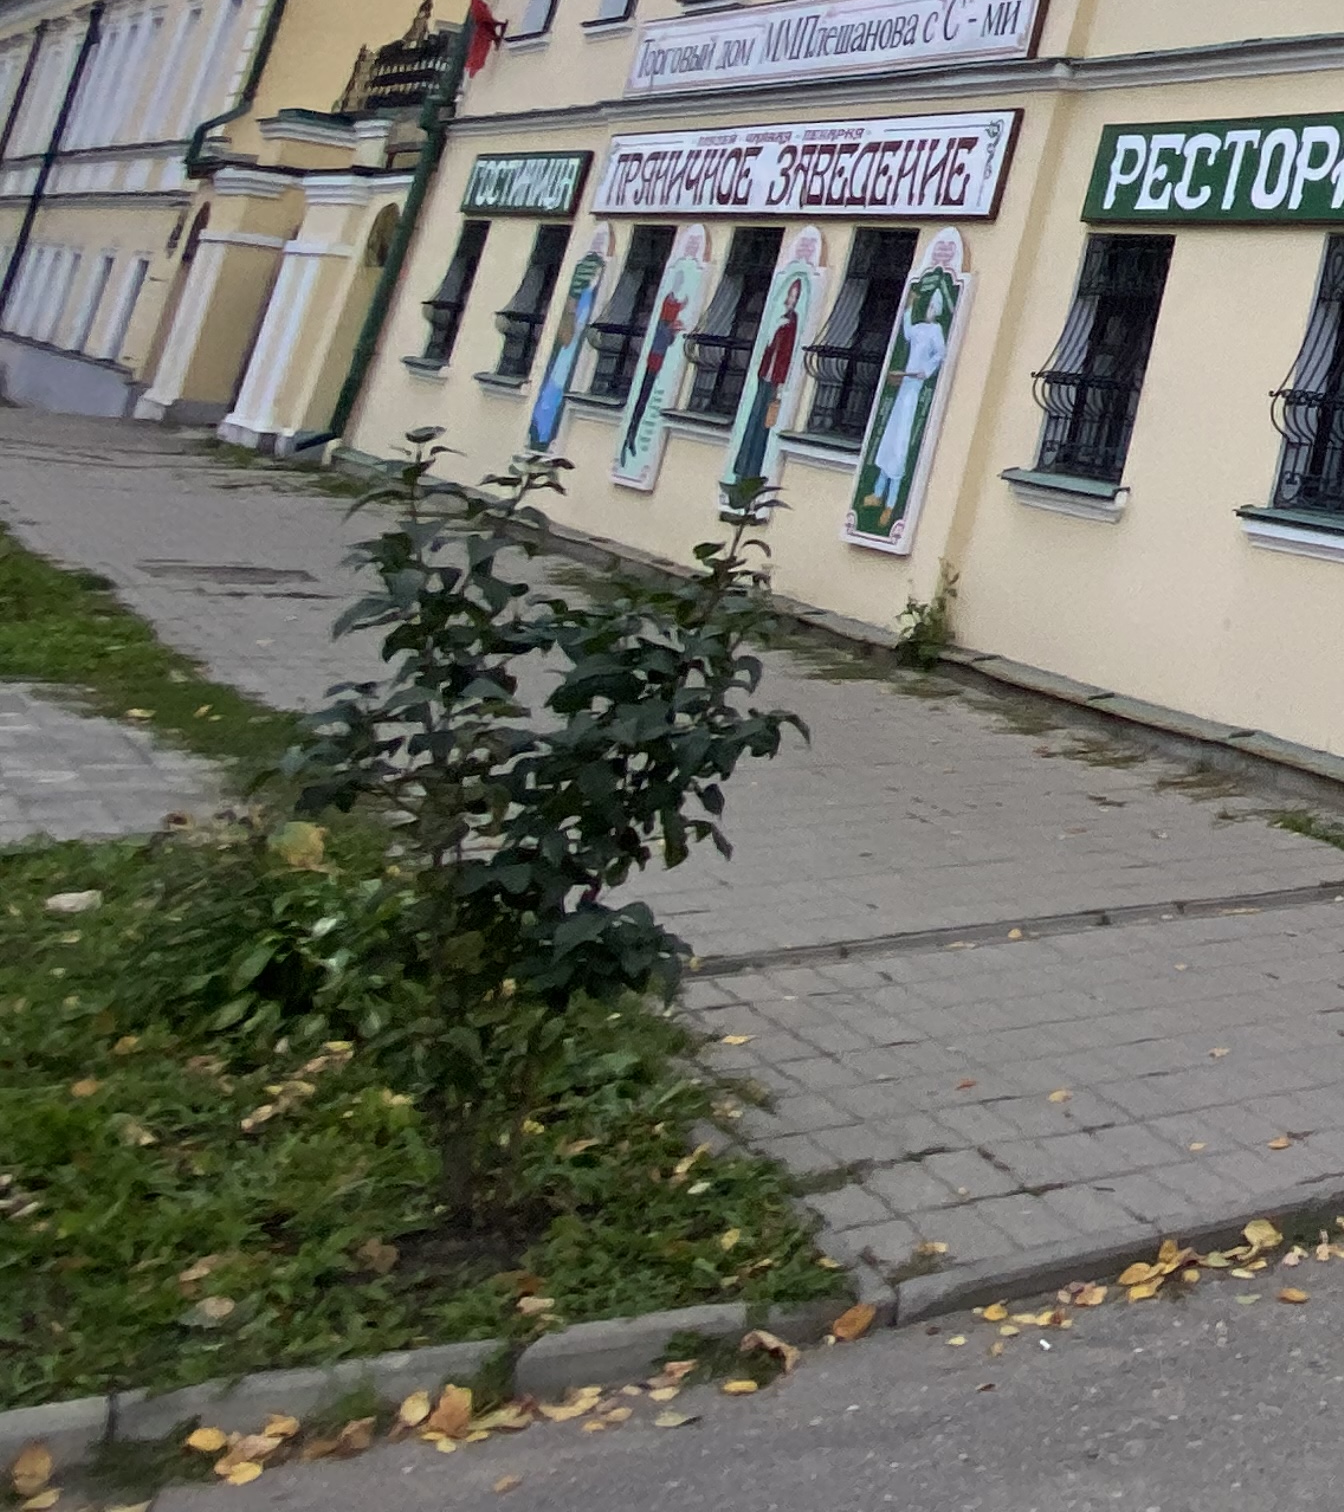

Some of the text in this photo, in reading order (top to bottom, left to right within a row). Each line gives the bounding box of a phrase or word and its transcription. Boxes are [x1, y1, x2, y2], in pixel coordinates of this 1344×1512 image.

[637, 38, 717, 88] Торговый
[463, 157, 581, 211] ГОСТИНИЦА
[606, 136, 979, 207] ПРЯНИЧНОЕ ЗАВЕДЕНИЕ
